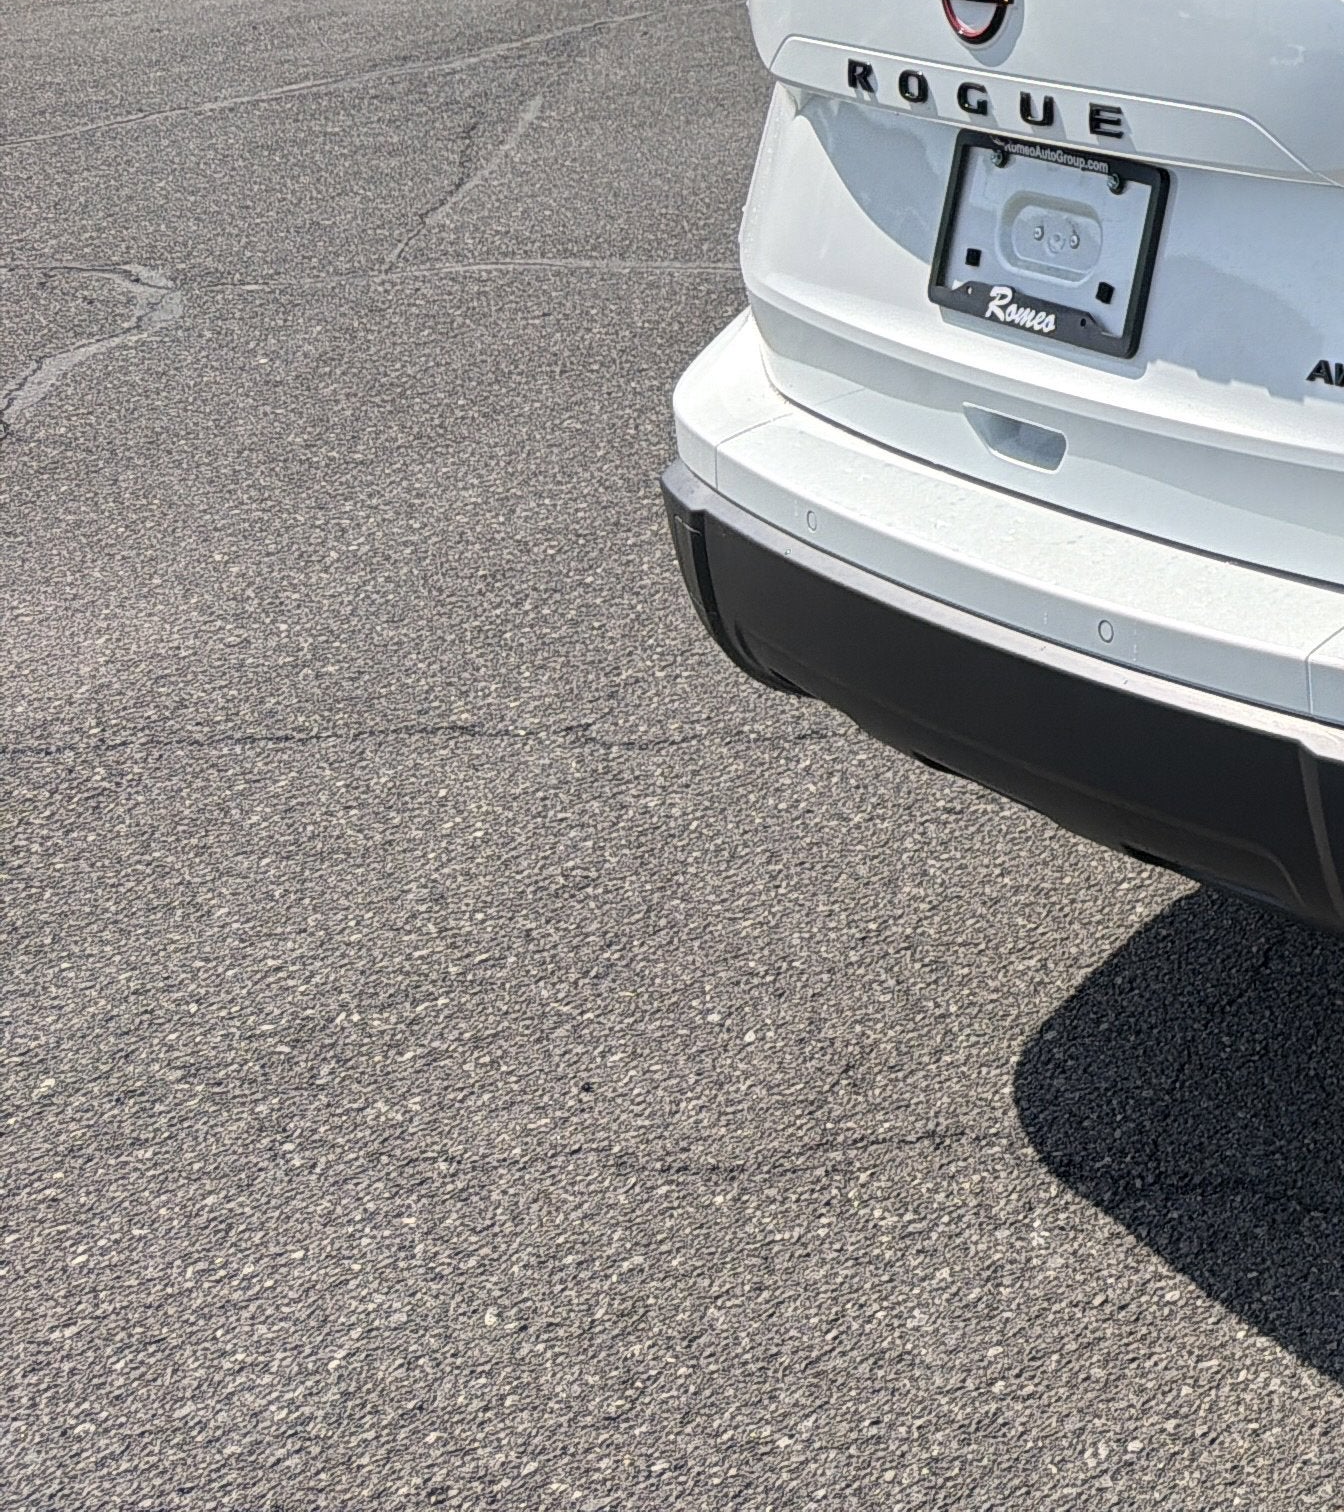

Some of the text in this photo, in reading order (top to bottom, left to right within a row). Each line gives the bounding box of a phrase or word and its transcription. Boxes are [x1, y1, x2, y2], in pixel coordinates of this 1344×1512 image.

[847, 58, 1125, 139] ROGUE
[1004, 142, 1109, 174] RomeoAutoGroup.com
[985, 285, 1057, 334] Romeo
